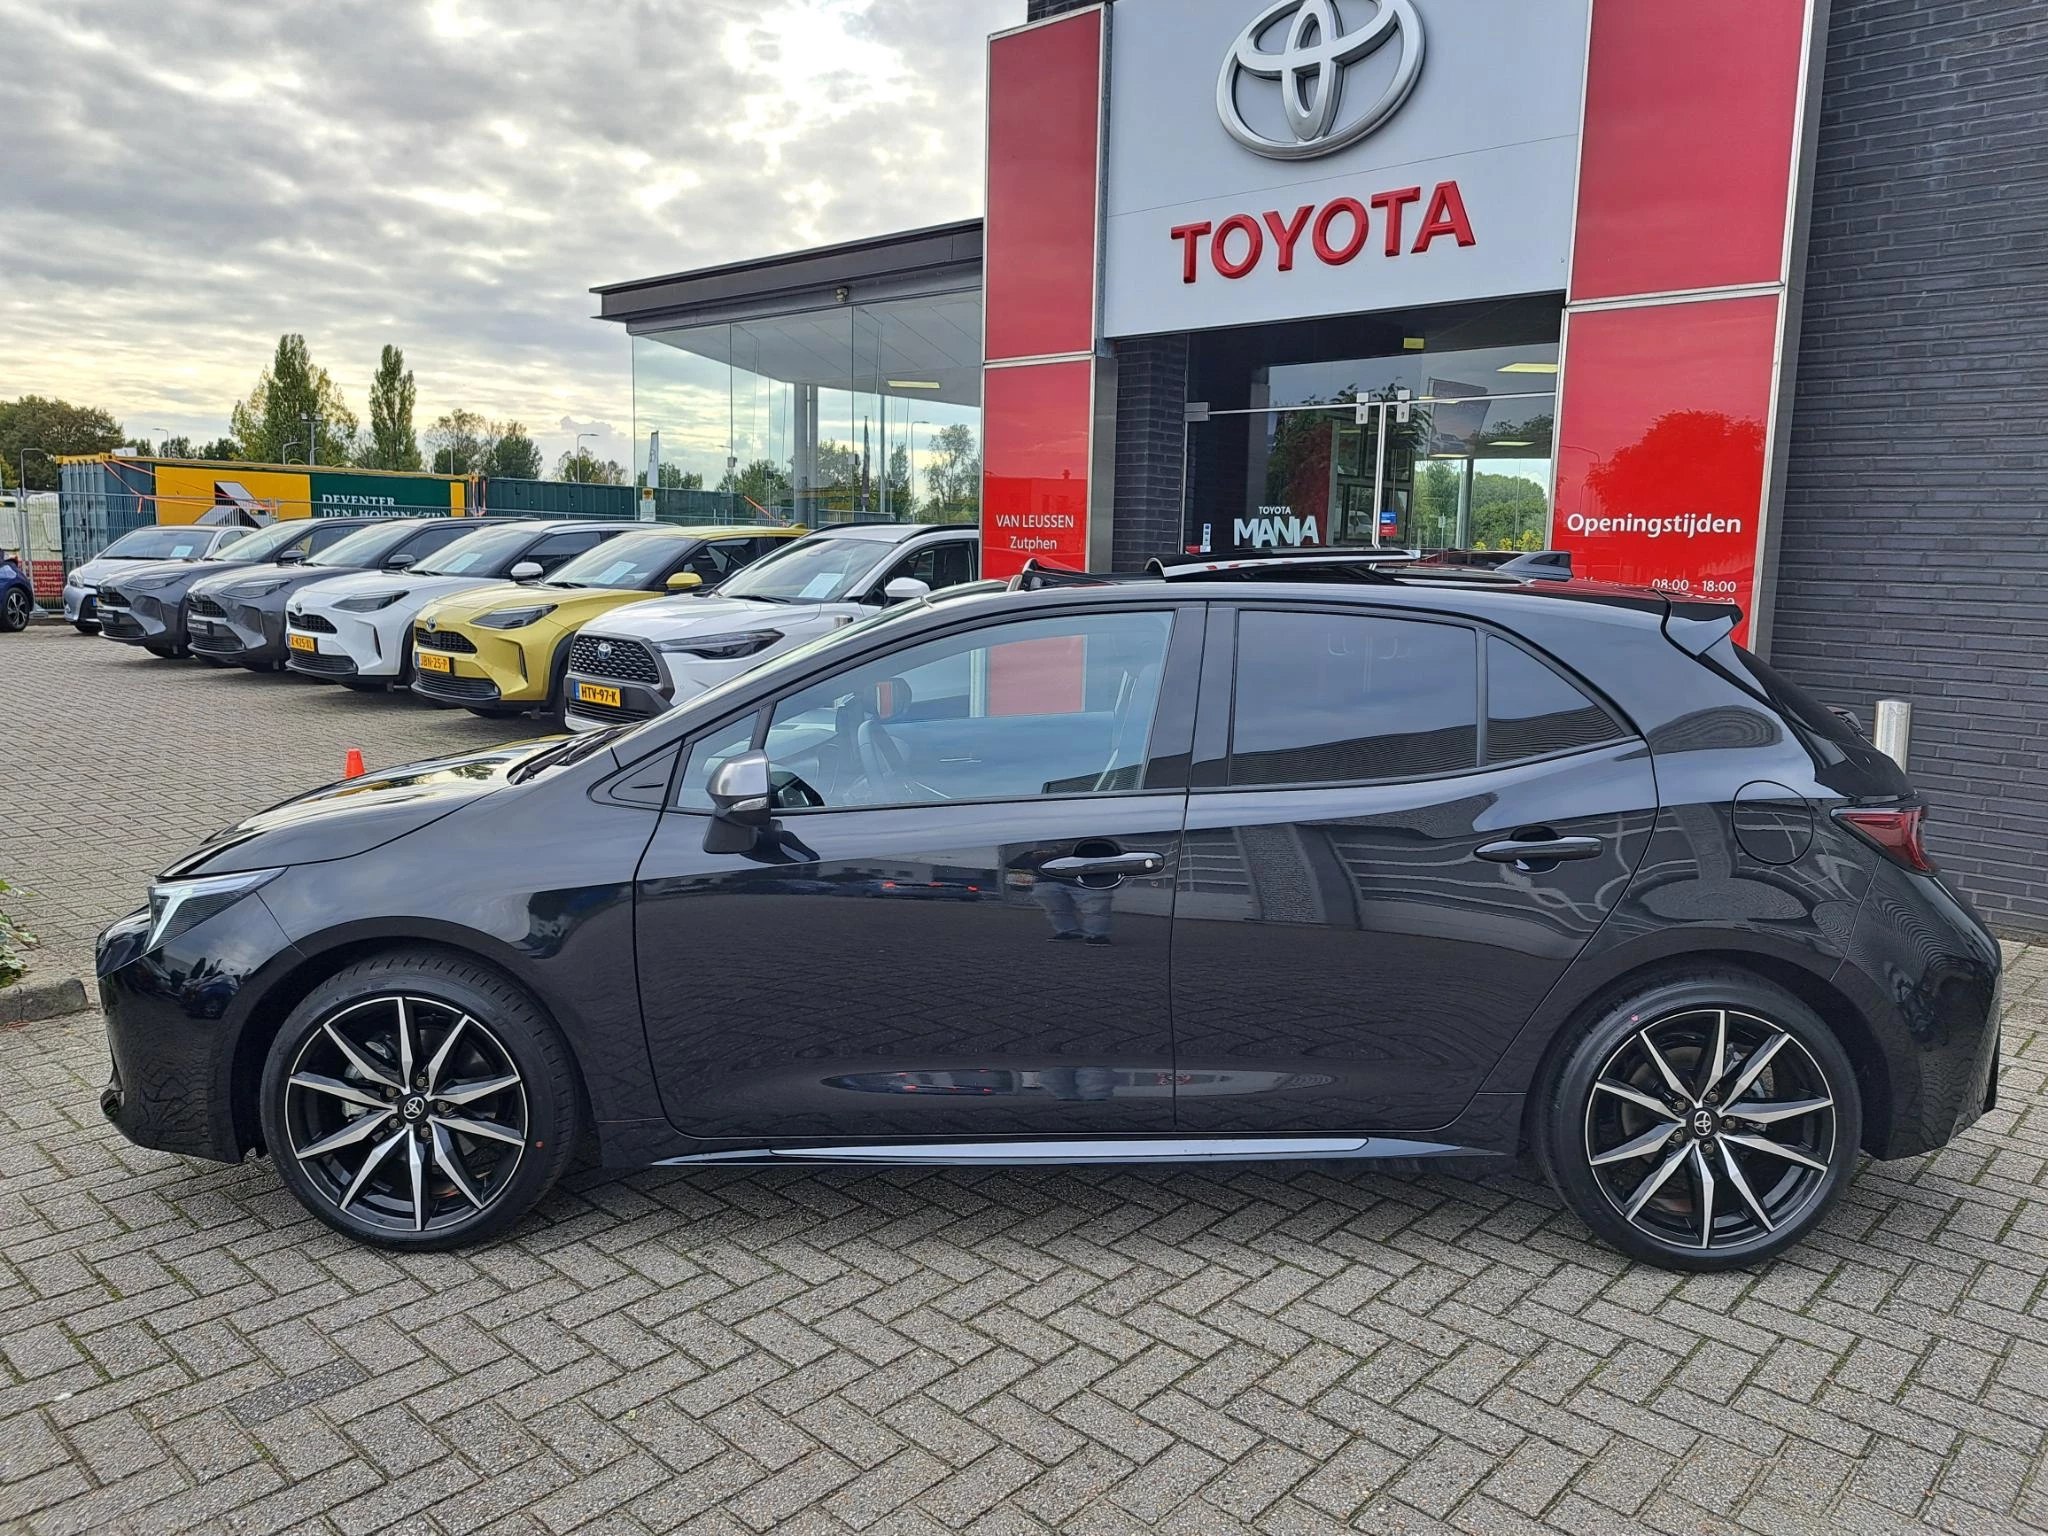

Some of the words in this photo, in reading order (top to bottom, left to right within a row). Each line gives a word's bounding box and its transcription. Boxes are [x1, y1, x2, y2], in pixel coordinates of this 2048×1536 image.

[1170, 180, 1476, 284] TOYOTA
[321, 493, 396, 506] DEVENTER
[322, 508, 352, 518] DEN
[1258, 506, 1291, 515] TOYOTA
[996, 514, 1020, 528] VAN
[1022, 514, 1074, 528] LEUSSEN
[1567, 513, 1742, 538] Openingstijden
[1233, 515, 1320, 549] MANIA
[1010, 536, 1058, 552] Zutphen
[1651, 578, 1689, 591] 08:00
[1702, 580, 1737, 593] 18:00
[581, 685, 618, 704] HTV-97-K
